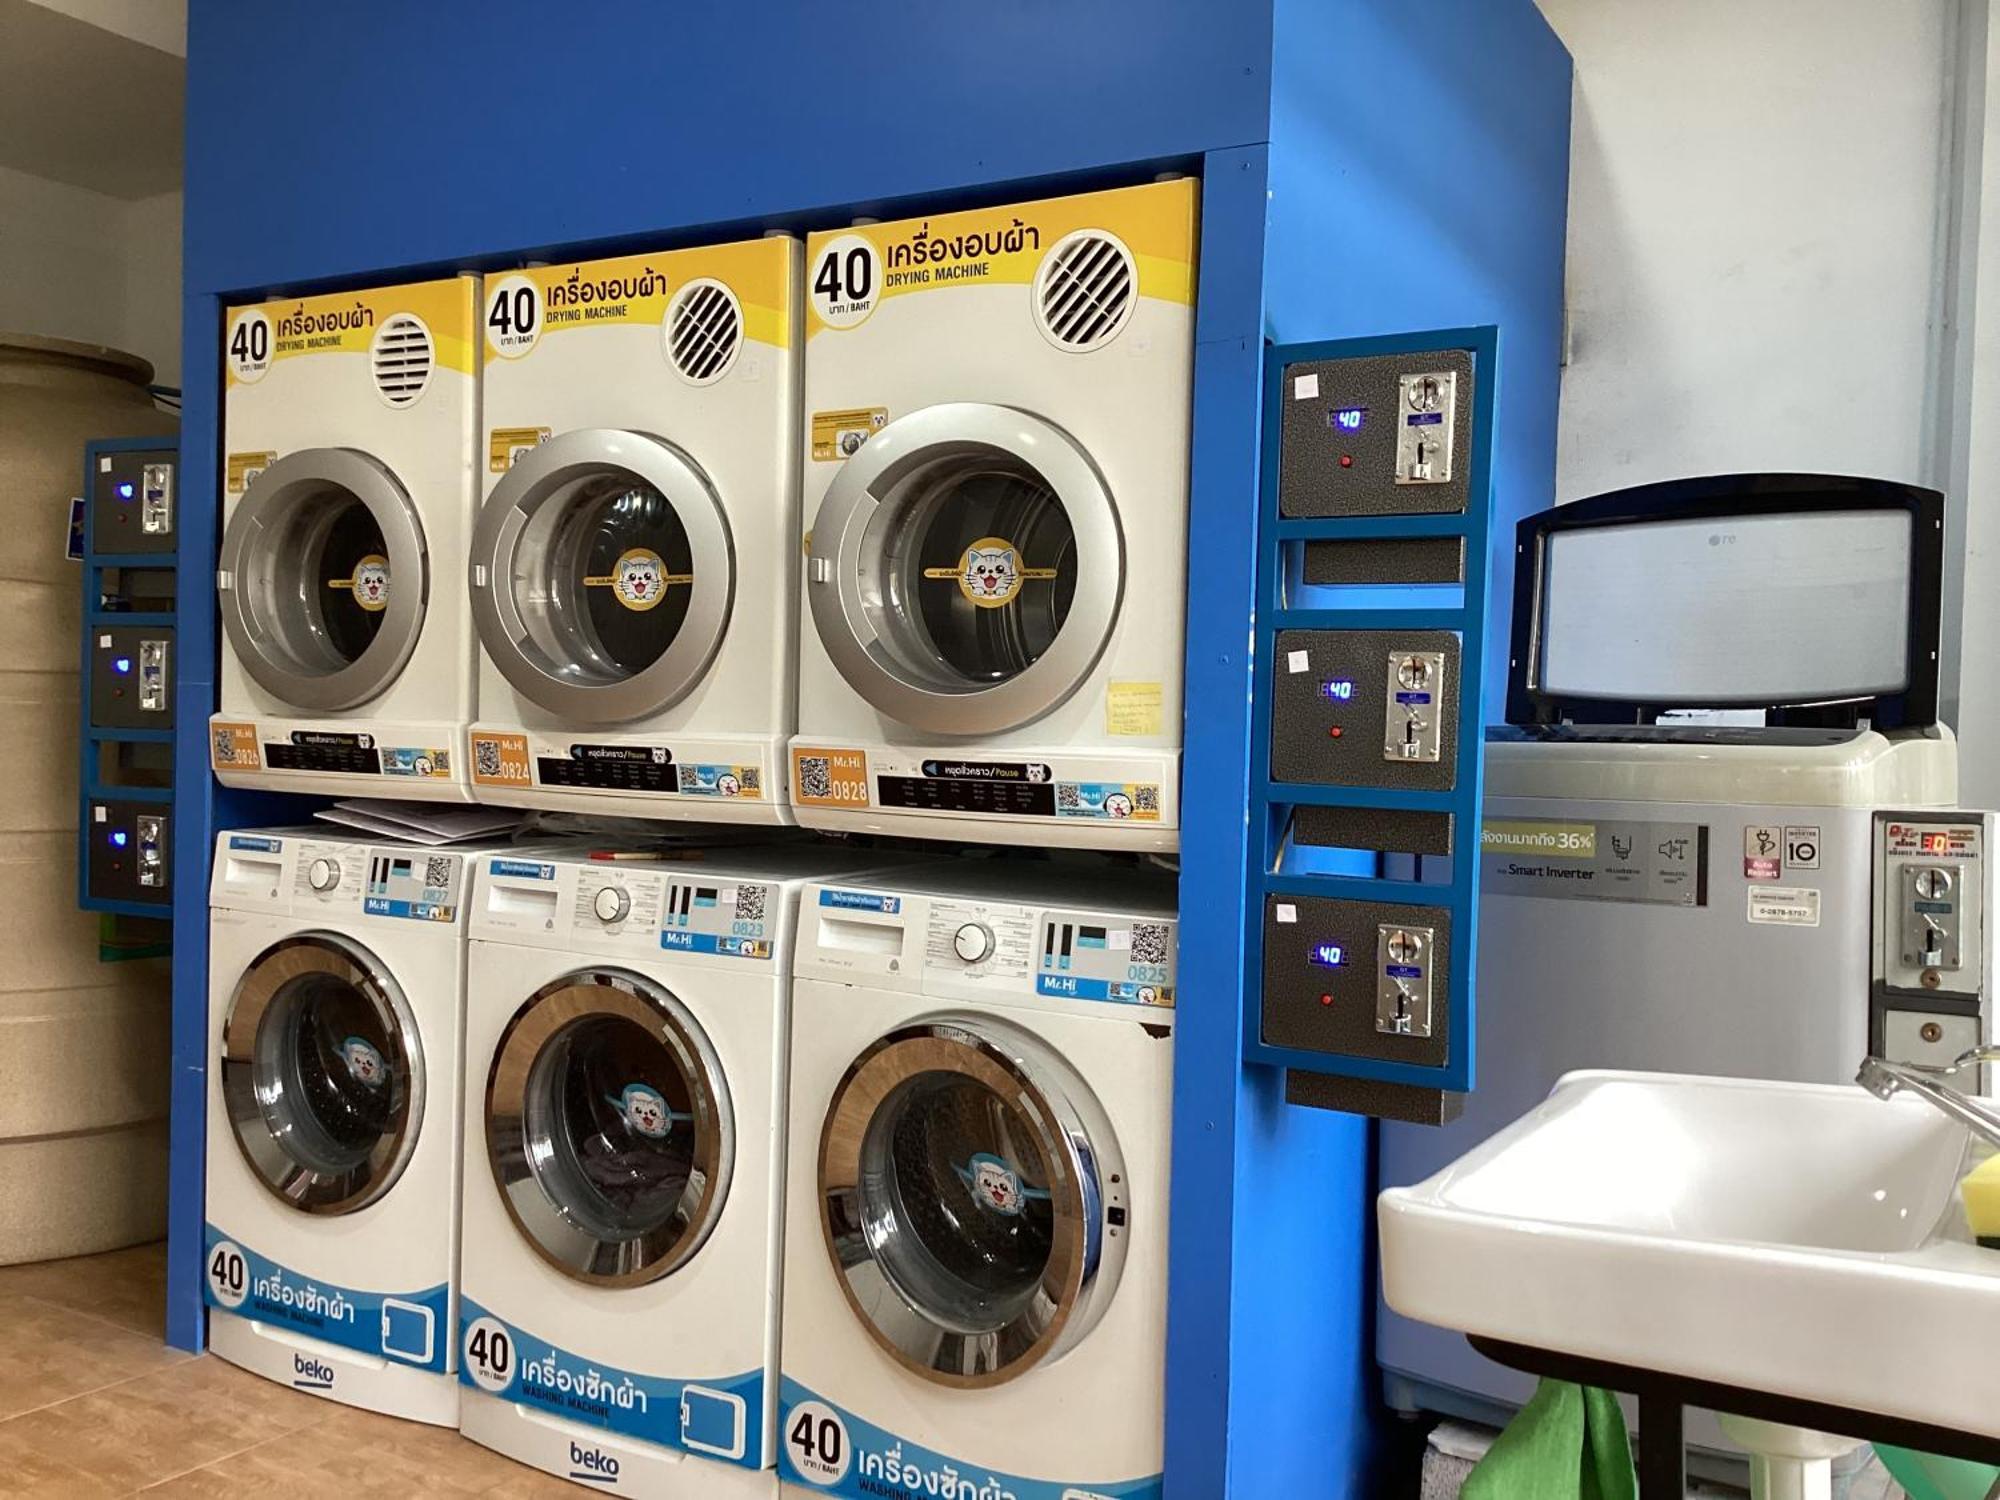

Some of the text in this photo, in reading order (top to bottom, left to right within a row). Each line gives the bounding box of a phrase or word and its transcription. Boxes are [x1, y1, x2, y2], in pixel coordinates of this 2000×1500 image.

[886, 219, 1039, 268] เครื่องอบผ้า
[547, 267, 667, 306] เครื่องอบผ้า
[814, 247, 871, 302] 40
[886, 262, 989, 287] DRYING MACHINE
[277, 302, 374, 337] เครื่องอบผ้า
[489, 287, 535, 335] 40
[546, 304, 627, 324] DRYING MACHINE
[850, 301, 870, 312] BAHT
[231, 320, 267, 362] 40
[276, 335, 341, 352] DRYING MACHINE
[1338, 411, 1360, 427] 40
[1330, 682, 1351, 699] 40
[502, 762, 529, 780] 0824
[832, 780, 868, 801] 0828
[1788, 842, 1816, 862] 10
[1508, 863, 1544, 877] Smart
[1546, 865, 1595, 880] Inverter
[732, 921, 764, 937] 0823
[1319, 946, 1341, 964] 40
[1044, 976, 1077, 991] Mr.Hi
[1127, 964, 1168, 983] 0825
[212, 1251, 243, 1290] 40
[254, 1269, 354, 1324] เครื่องซักผ้า
[469, 1328, 508, 1373] 40
[294, 1353, 334, 1384] beko
[522, 1351, 647, 1413] เครื่องซักผ้า
[522, 1385, 610, 1419] WASHING MACHINE
[791, 1412, 841, 1465] 40
[570, 1441, 619, 1476] beko
